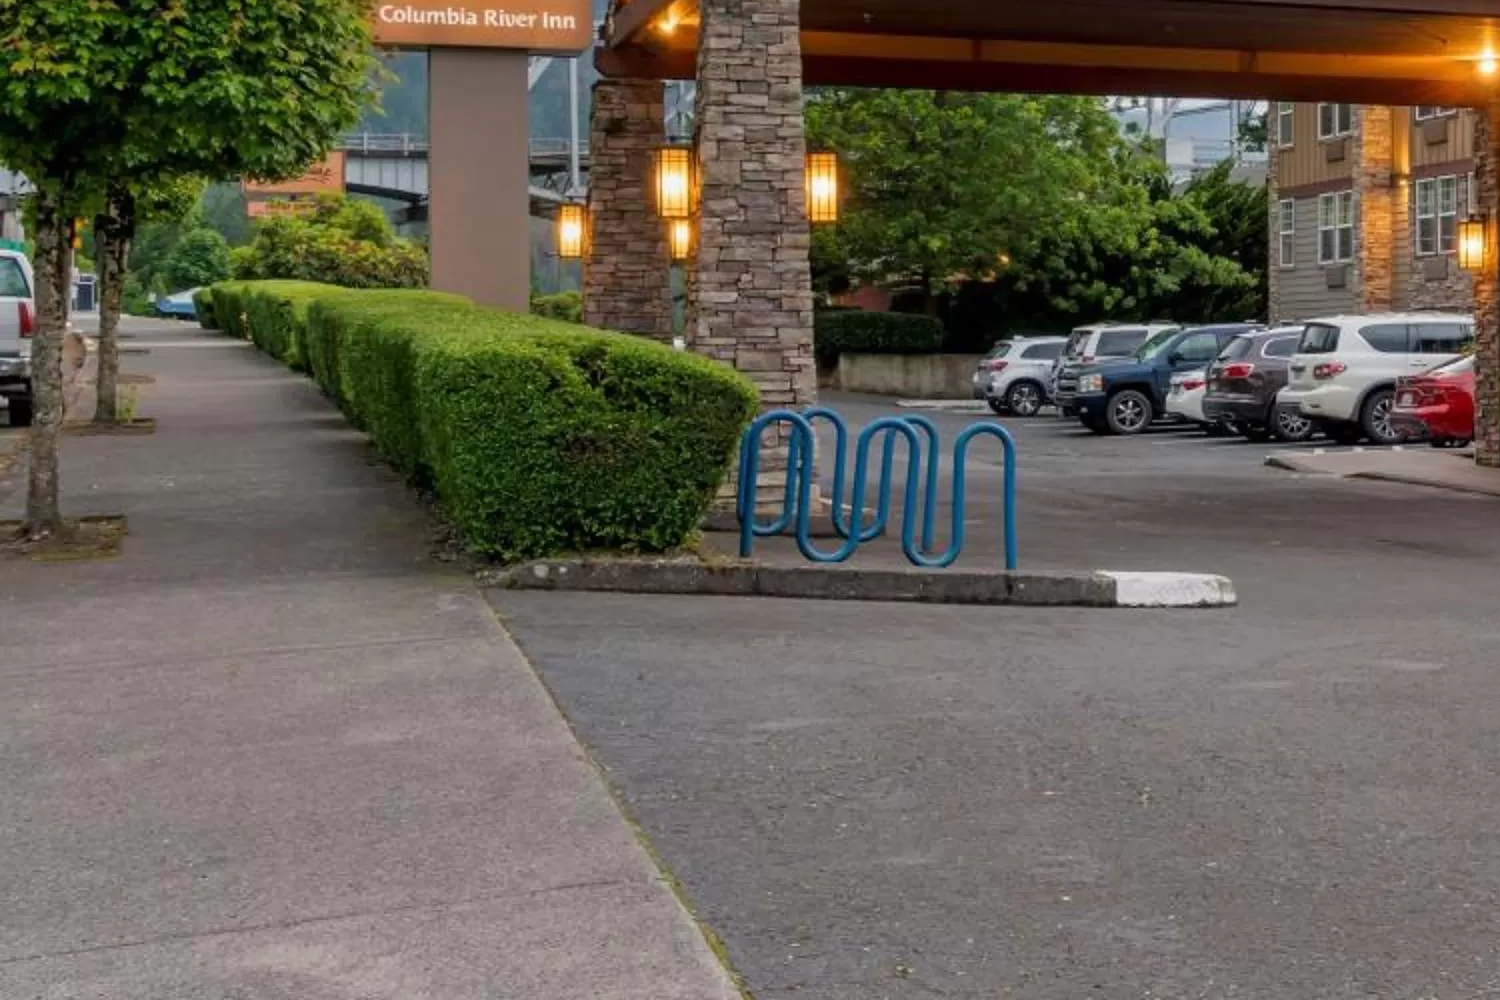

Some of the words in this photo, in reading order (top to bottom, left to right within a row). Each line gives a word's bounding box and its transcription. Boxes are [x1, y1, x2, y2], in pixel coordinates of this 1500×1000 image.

[379, 5, 478, 26] Columbia
[484, 9, 538, 28] River
[542, 11, 577, 30] Inn
